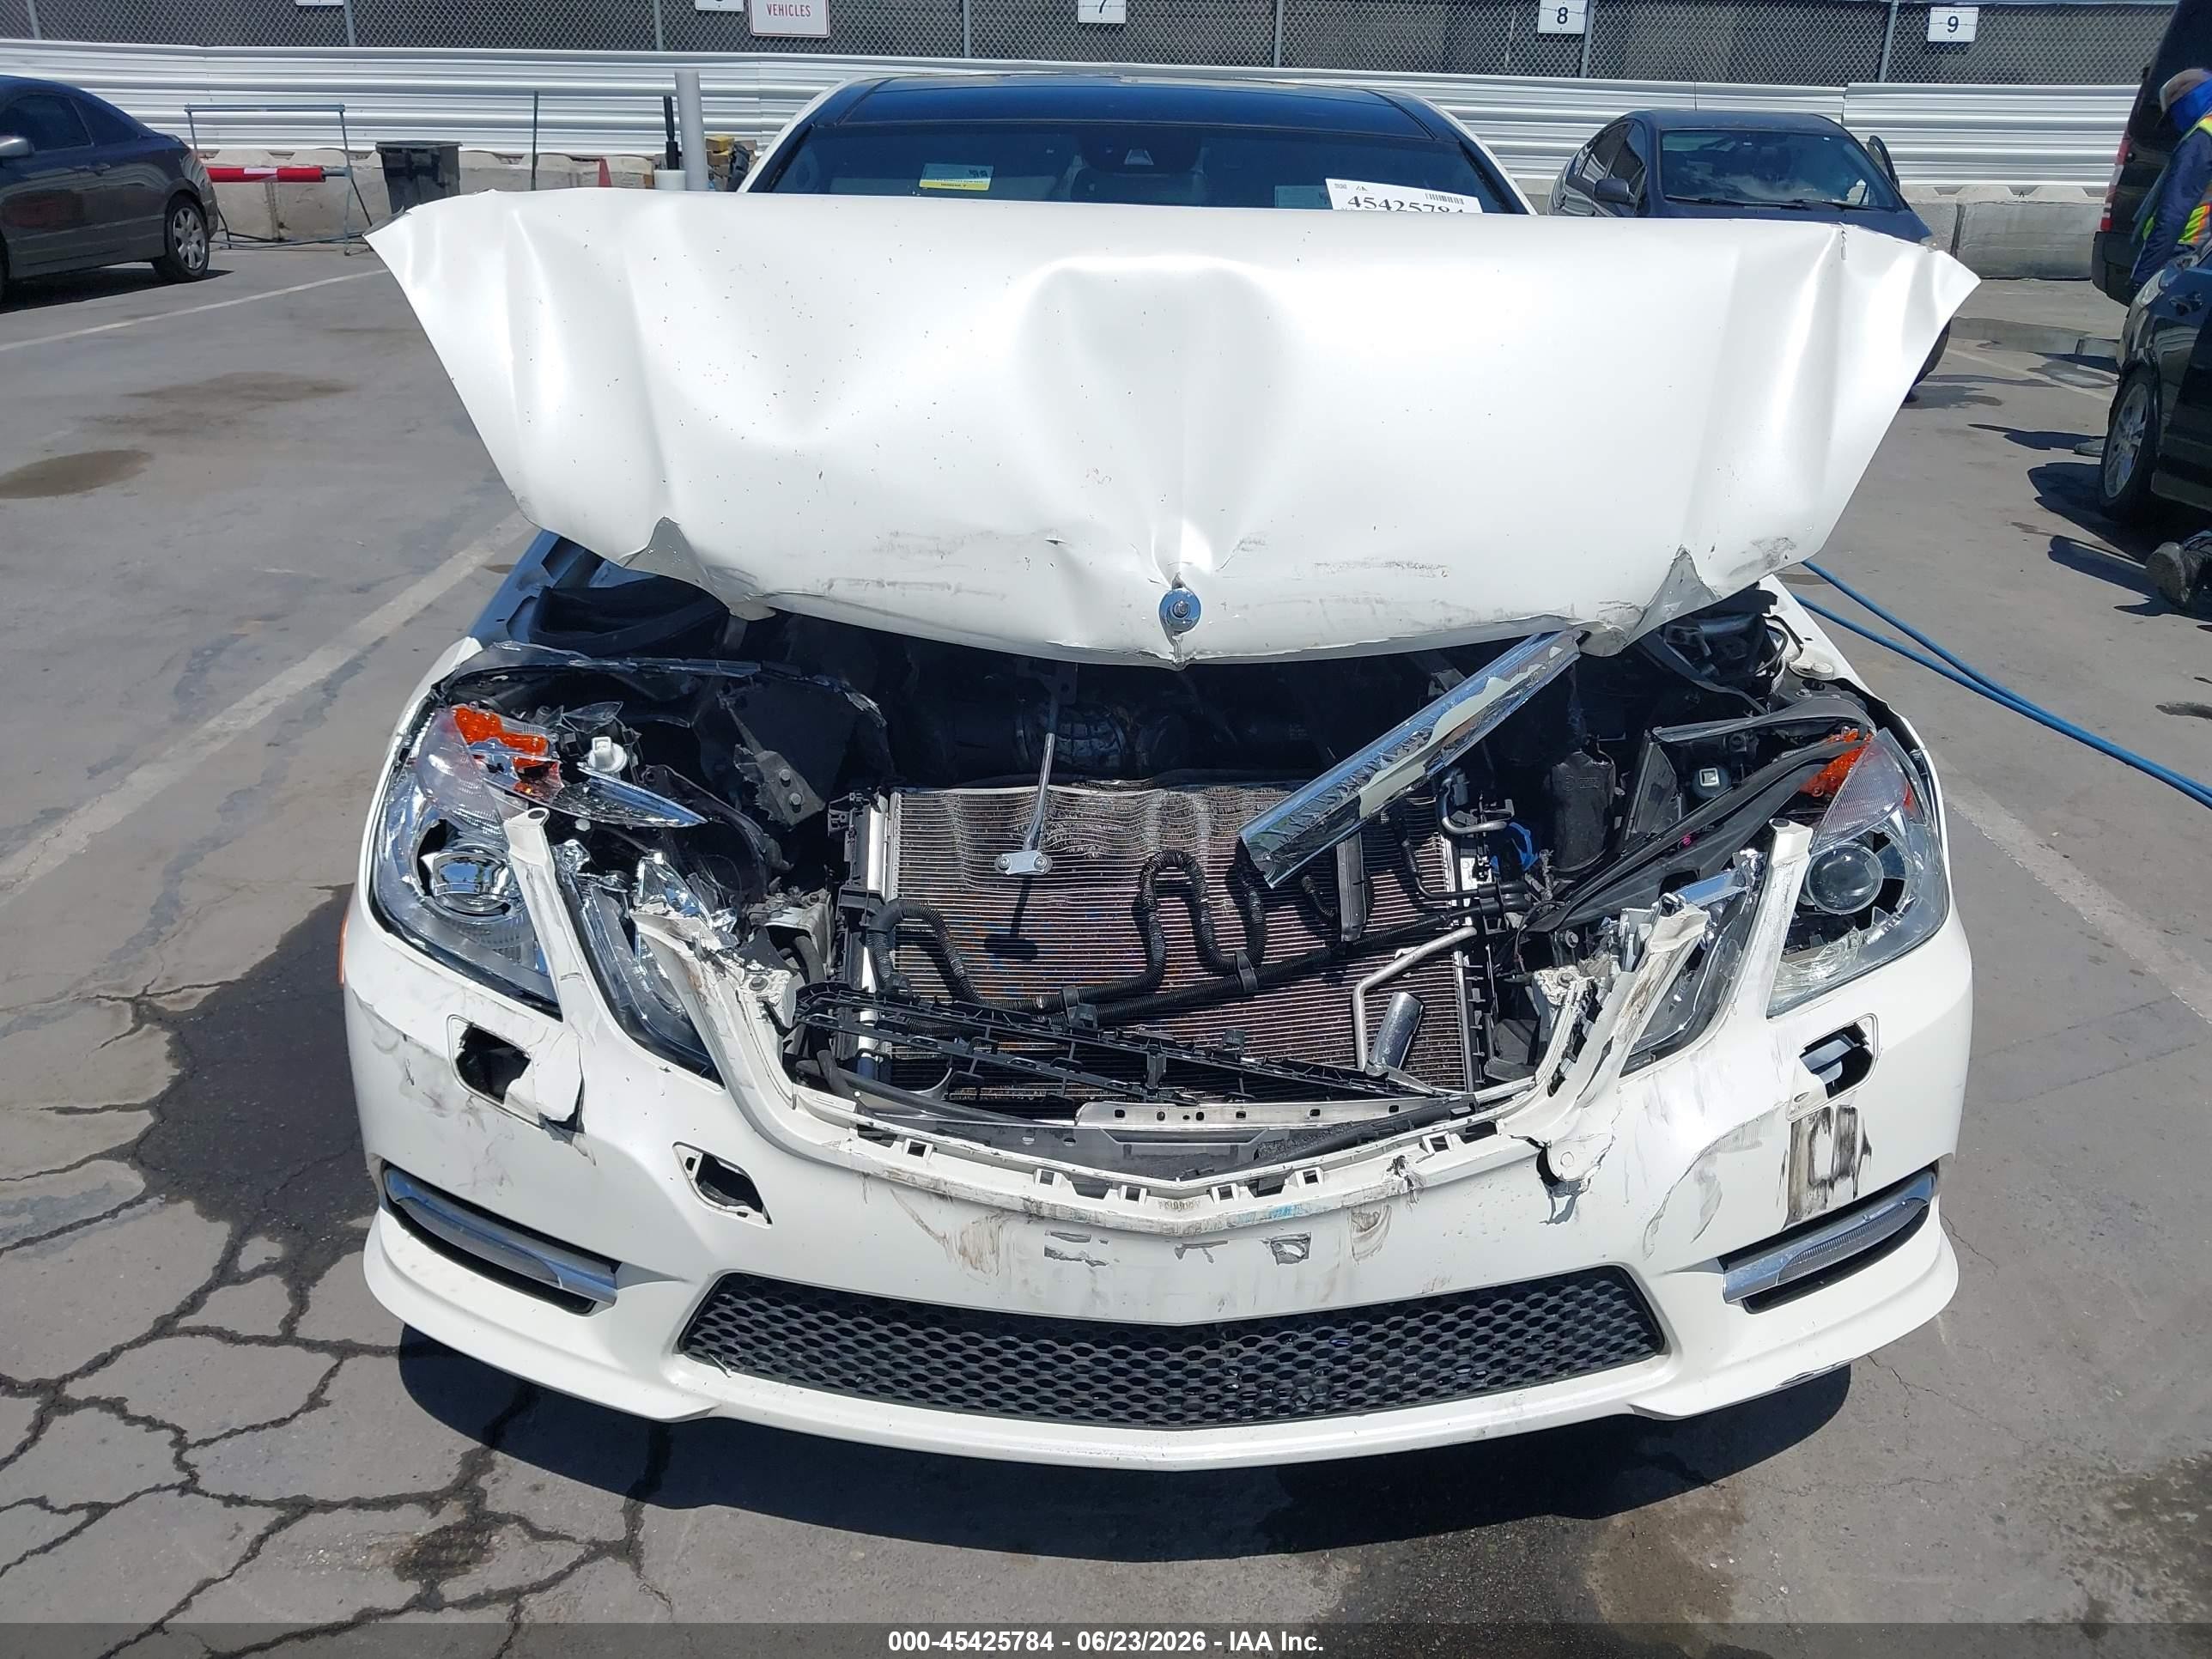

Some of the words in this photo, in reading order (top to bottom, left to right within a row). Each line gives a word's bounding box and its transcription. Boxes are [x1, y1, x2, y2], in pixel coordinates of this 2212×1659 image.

[767, 3, 811, 17] VEHICLES
[1556, 6, 1569, 25] 8
[1947, 15, 1960, 33] 9
[1347, 195, 1464, 213] 4542578
